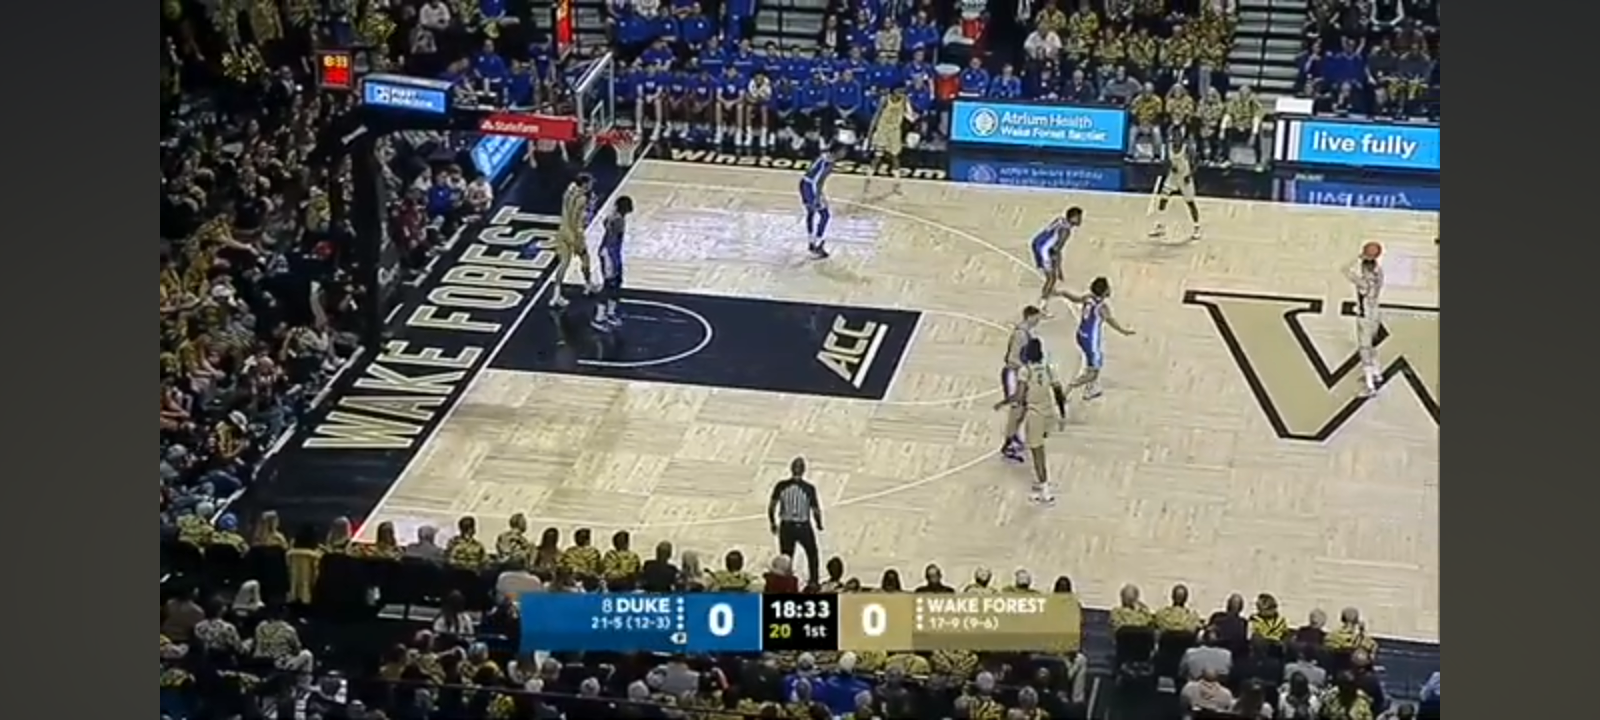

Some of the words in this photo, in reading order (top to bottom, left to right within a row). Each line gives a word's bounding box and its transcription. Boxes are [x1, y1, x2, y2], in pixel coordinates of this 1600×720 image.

[1001, 111, 1048, 126] Atrium
[1050, 113, 1093, 128] Health
[1001, 126, 1031, 138] Wake
[1313, 130, 1355, 151] live
[1361, 133, 1417, 159] fully
[670, 149, 812, 170] Winston
[301, 339, 485, 449] WAKE
[406, 204, 563, 333] FOREST
[816, 314, 878, 381] ACC
